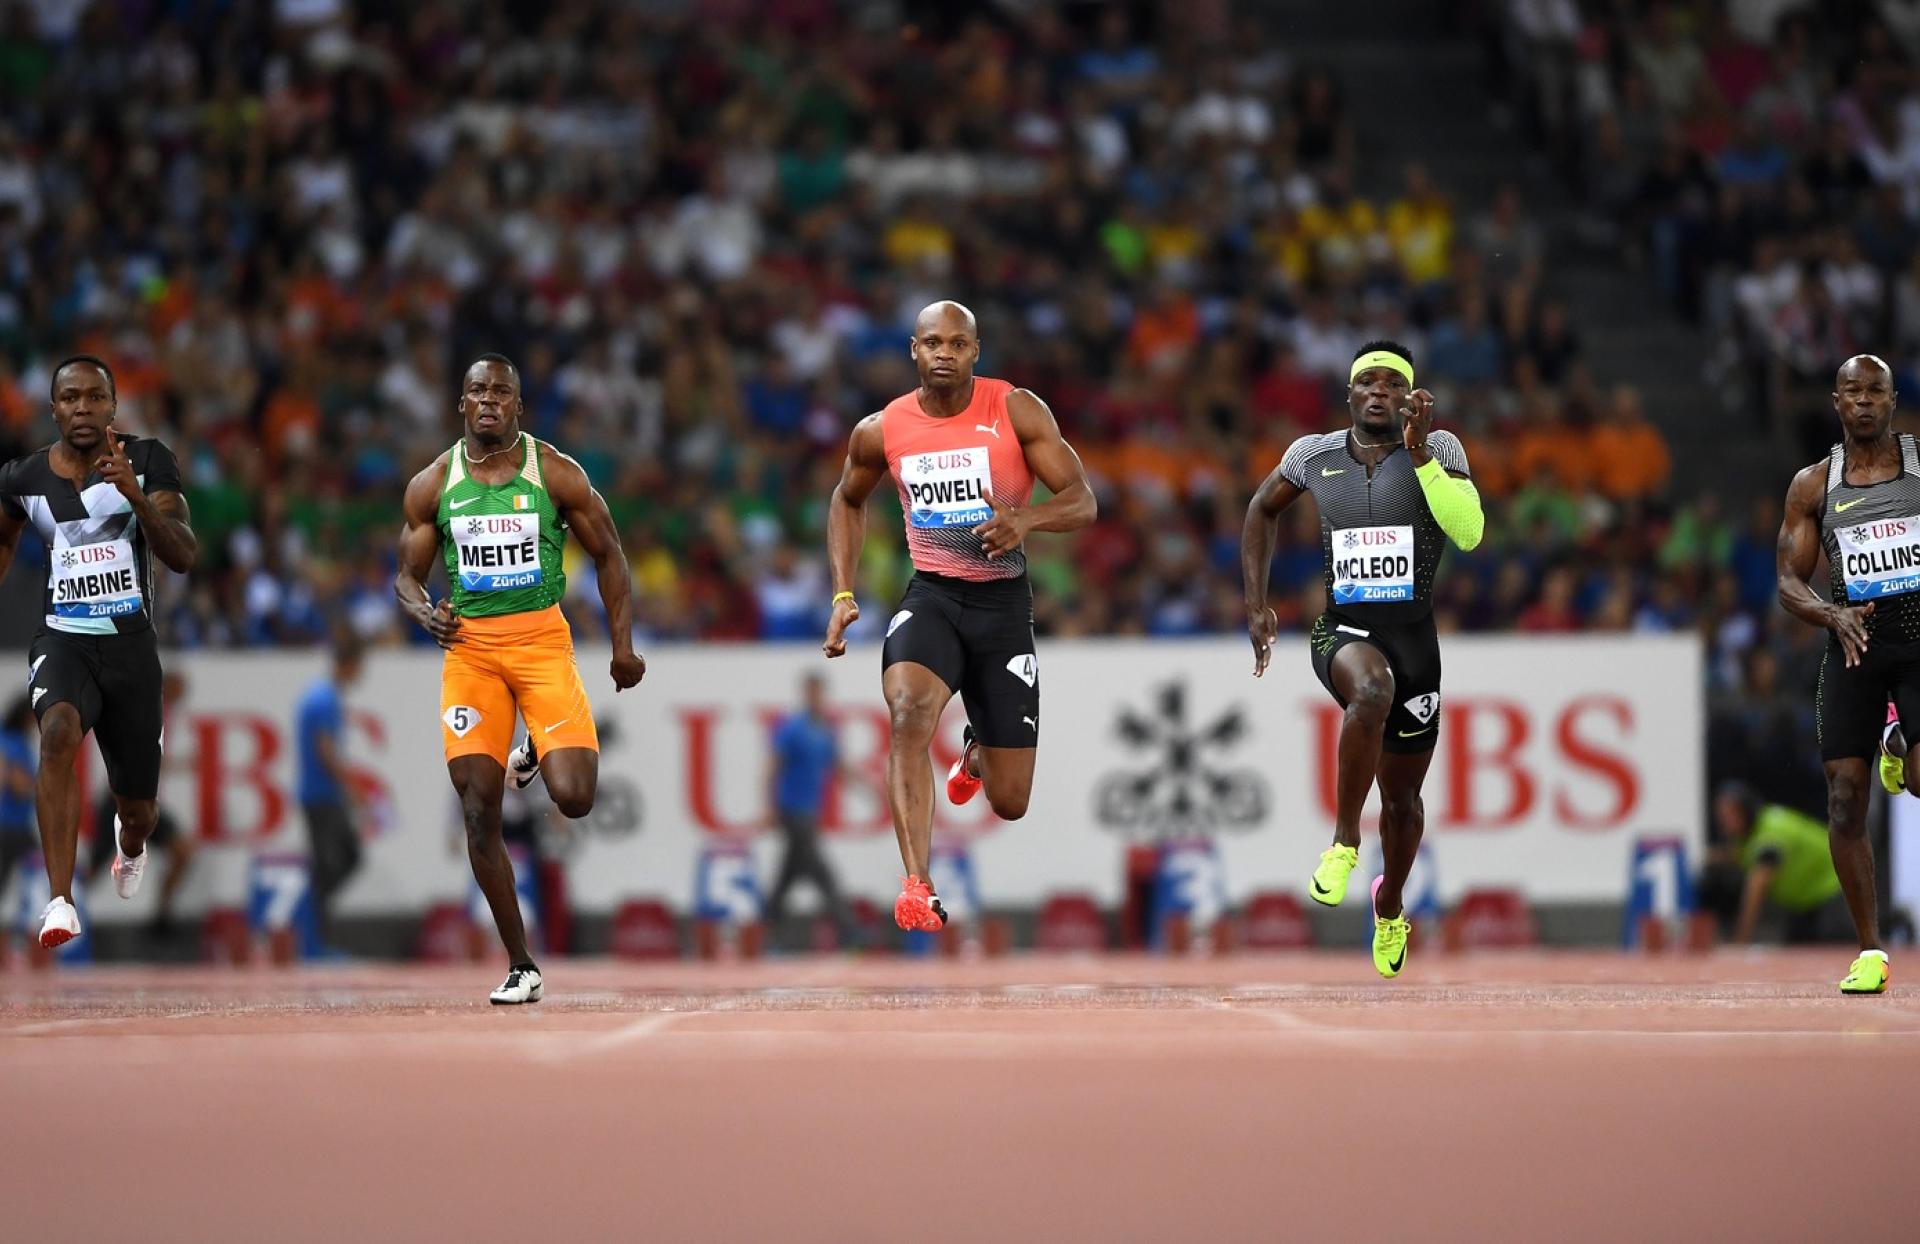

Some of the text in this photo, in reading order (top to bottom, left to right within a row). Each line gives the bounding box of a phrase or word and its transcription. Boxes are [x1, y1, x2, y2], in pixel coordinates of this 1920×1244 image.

[937, 453, 972, 470] UBS
[487, 518, 522, 533] UBS
[942, 510, 988, 525] Zürich
[1362, 530, 1397, 546] UBS
[1872, 521, 1906, 539] UBS
[80, 545, 116, 563] UBS
[461, 537, 534, 567] MEITÉ
[1847, 544, 1920, 576] COLLINS
[1336, 556, 1409, 580] MCLEOD
[57, 568, 132, 601] SIMBINE
[491, 573, 535, 587] Zürich
[1363, 587, 1406, 599] Zürich
[89, 601, 133, 616] Zürich
[1023, 656, 1034, 681] 4
[1418, 695, 1432, 718] 3
[453, 707, 469, 731] 5
[254, 866, 308, 926] 7
[708, 858, 760, 924] 5
[1640, 851, 1679, 920] 1
